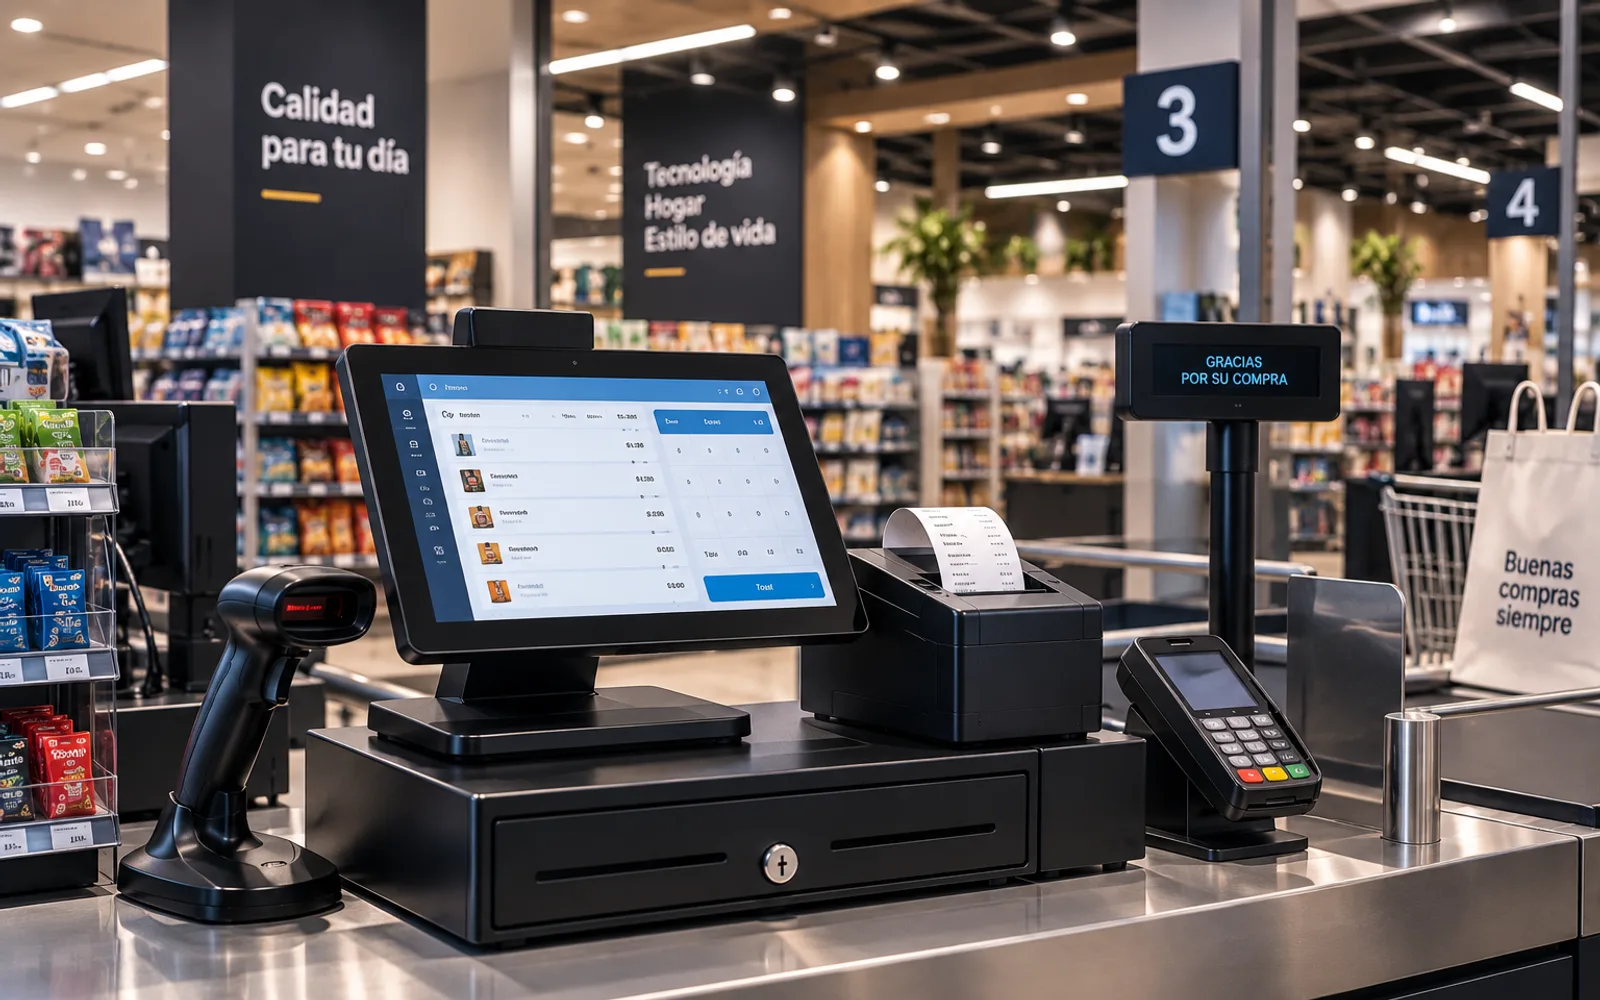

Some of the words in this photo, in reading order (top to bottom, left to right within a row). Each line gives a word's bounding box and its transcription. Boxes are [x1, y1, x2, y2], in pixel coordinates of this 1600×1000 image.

[261, 81, 376, 129] Calidad
[1156, 85, 1198, 156] 3
[261, 134, 328, 170] para
[332, 136, 363, 170] tu
[366, 137, 411, 175] día
[643, 149, 753, 188] Tecnología
[644, 193, 706, 225] Hogar
[1505, 177, 1540, 228] 4
[644, 223, 700, 254] Estilo
[700, 220, 729, 249] de
[730, 216, 777, 247] vida
[1181, 372, 1209, 385] POR
[1211, 372, 1229, 385] SU
[1232, 372, 1288, 386] COMPRA
[1206, 355, 1263, 369] GRACIAS
[1504, 549, 1574, 580] Buenas
[1499, 581, 1581, 610] compras
[1496, 604, 1572, 637] siempre
